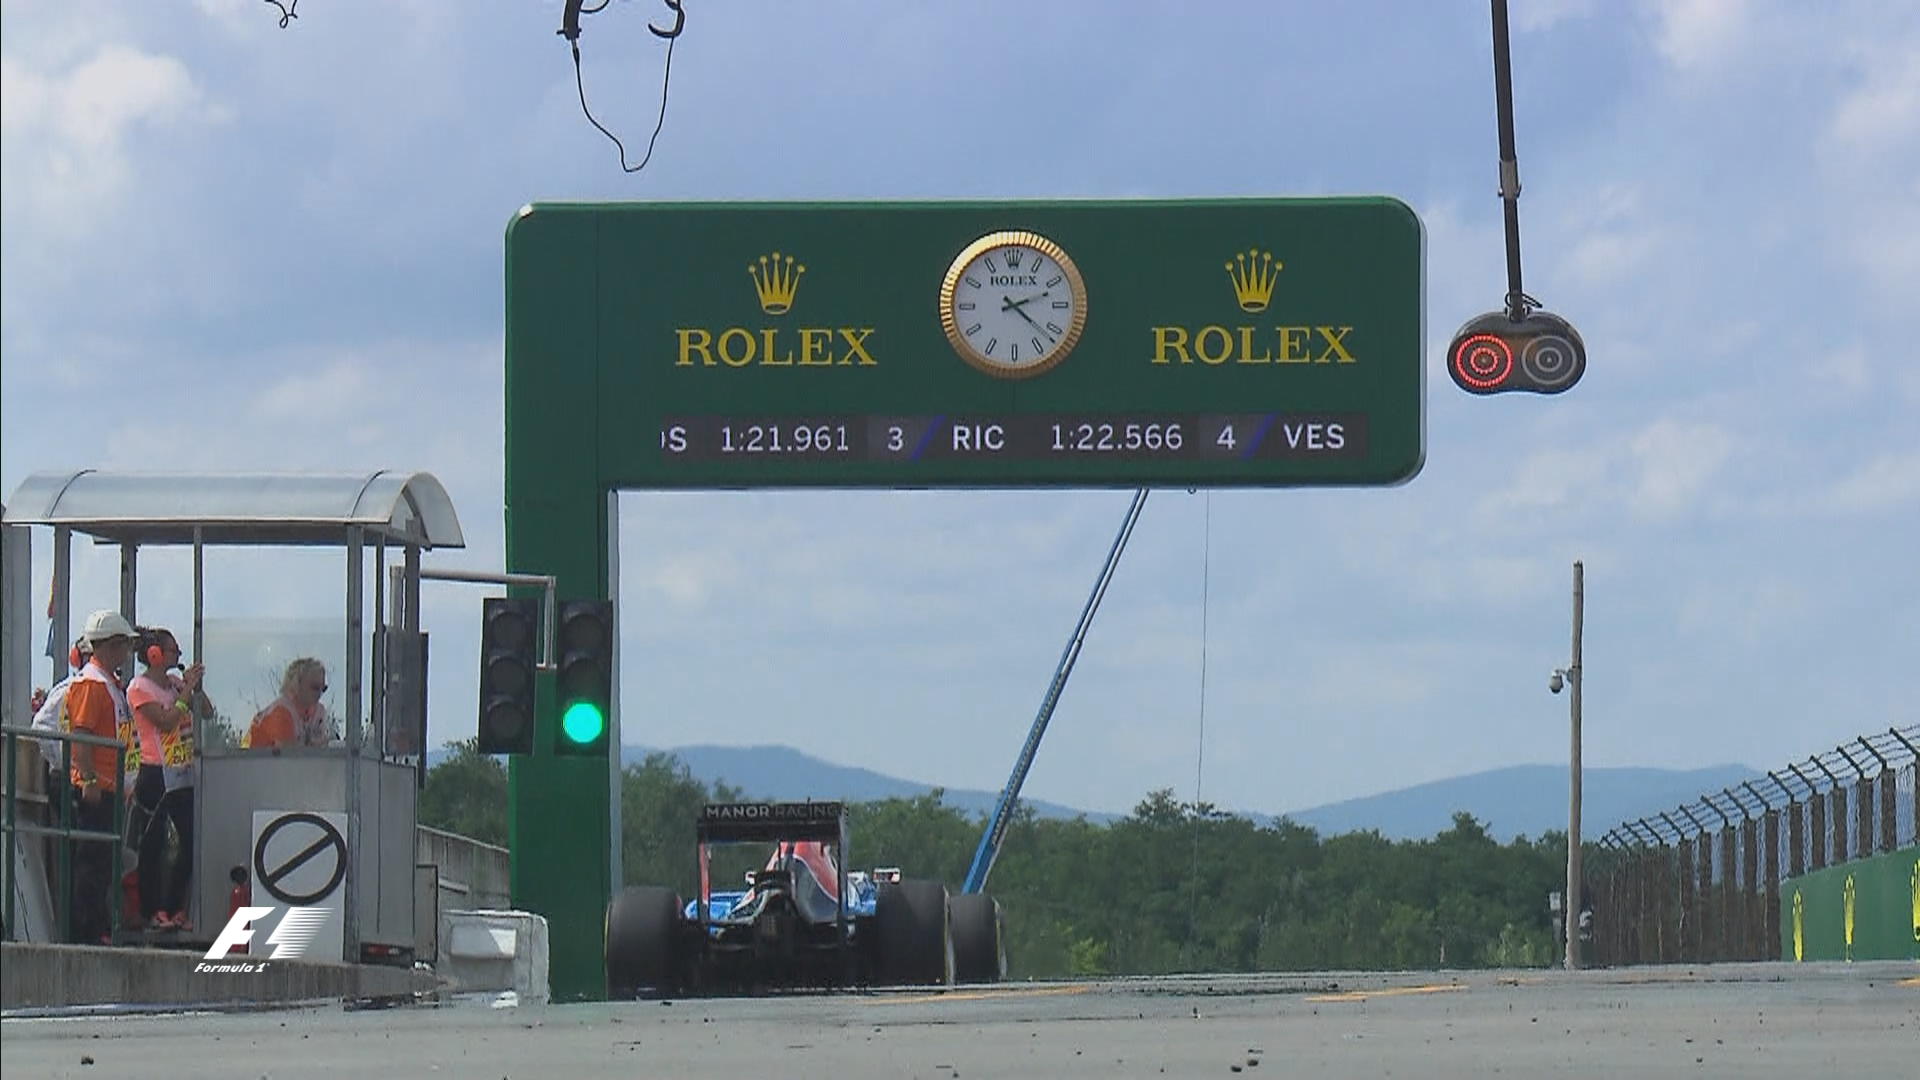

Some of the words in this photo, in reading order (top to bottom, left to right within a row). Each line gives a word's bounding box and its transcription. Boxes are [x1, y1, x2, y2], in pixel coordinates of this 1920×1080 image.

[990, 275, 1038, 287] ROLEX
[675, 327, 878, 367] ROLEX
[1151, 325, 1356, 364] ROLEX
[661, 425, 687, 452] S
[721, 425, 849, 452] 1:21.961
[887, 426, 903, 451] 3
[952, 425, 1005, 451] RIC
[1052, 424, 1183, 450] 1:22.566
[1216, 424, 1236, 449] 4
[1283, 423, 1345, 449] VES
[706, 805, 770, 819] MANOR
